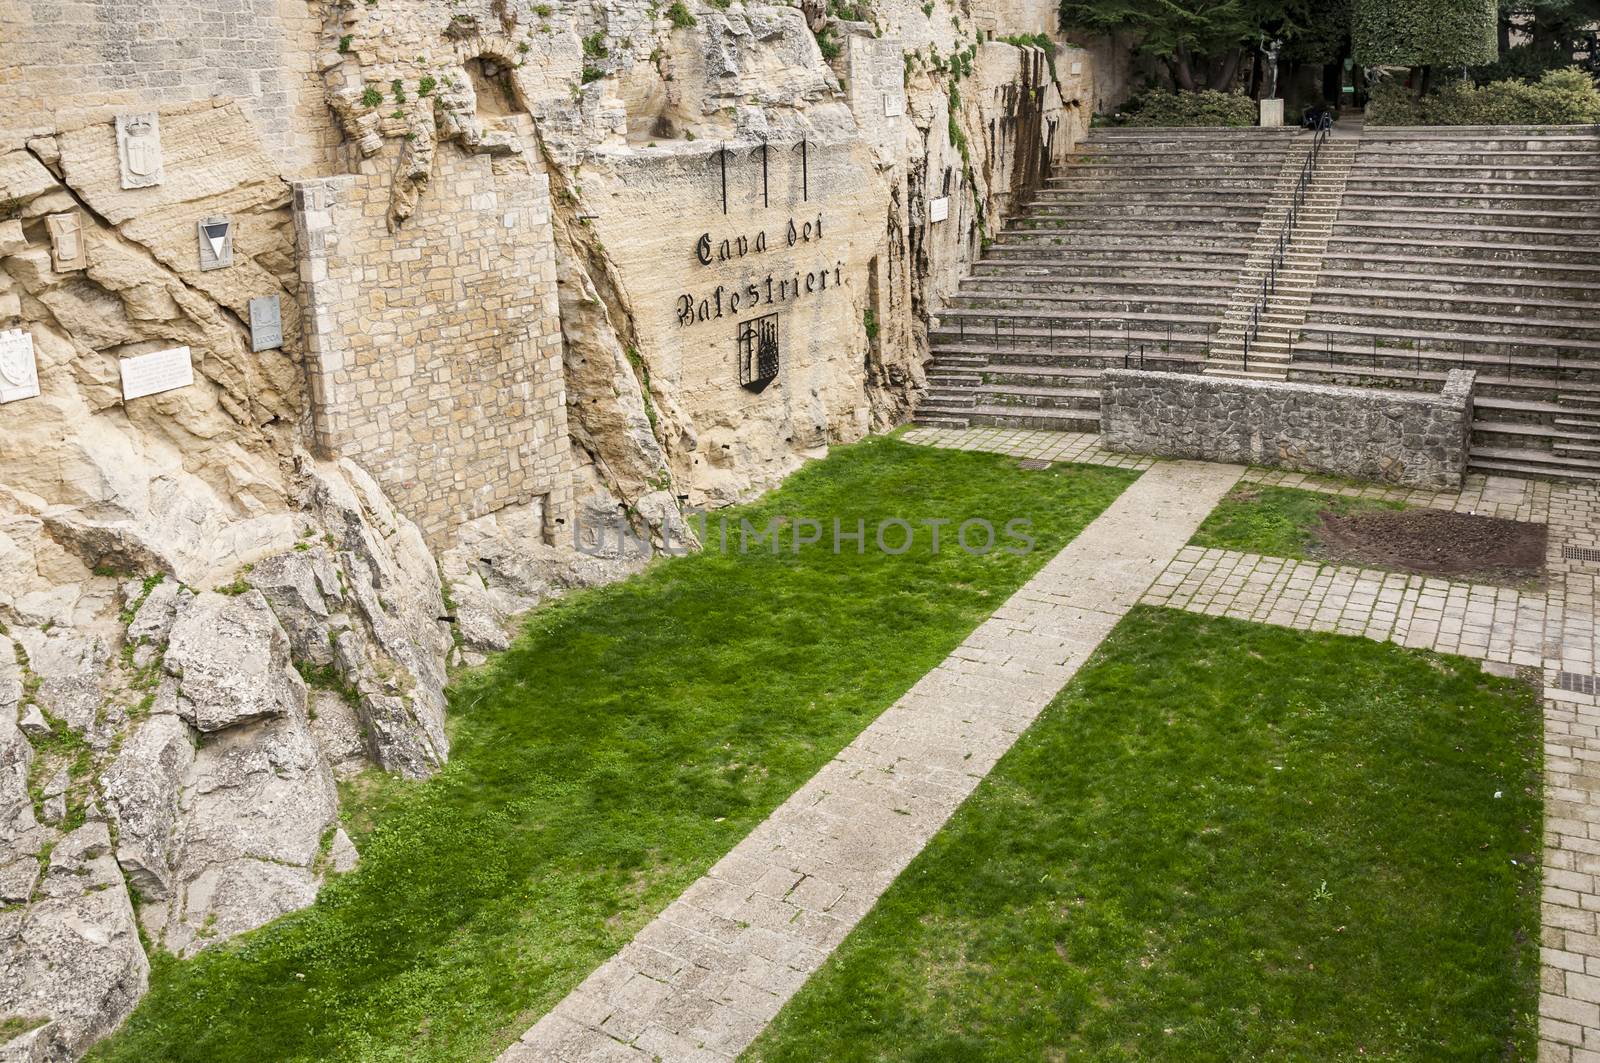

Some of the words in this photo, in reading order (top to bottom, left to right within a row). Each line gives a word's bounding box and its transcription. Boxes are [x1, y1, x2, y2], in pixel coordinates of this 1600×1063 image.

[697, 230, 768, 266] Cava
[787, 212, 823, 247] dei
[676, 261, 842, 328] Balestrieri
